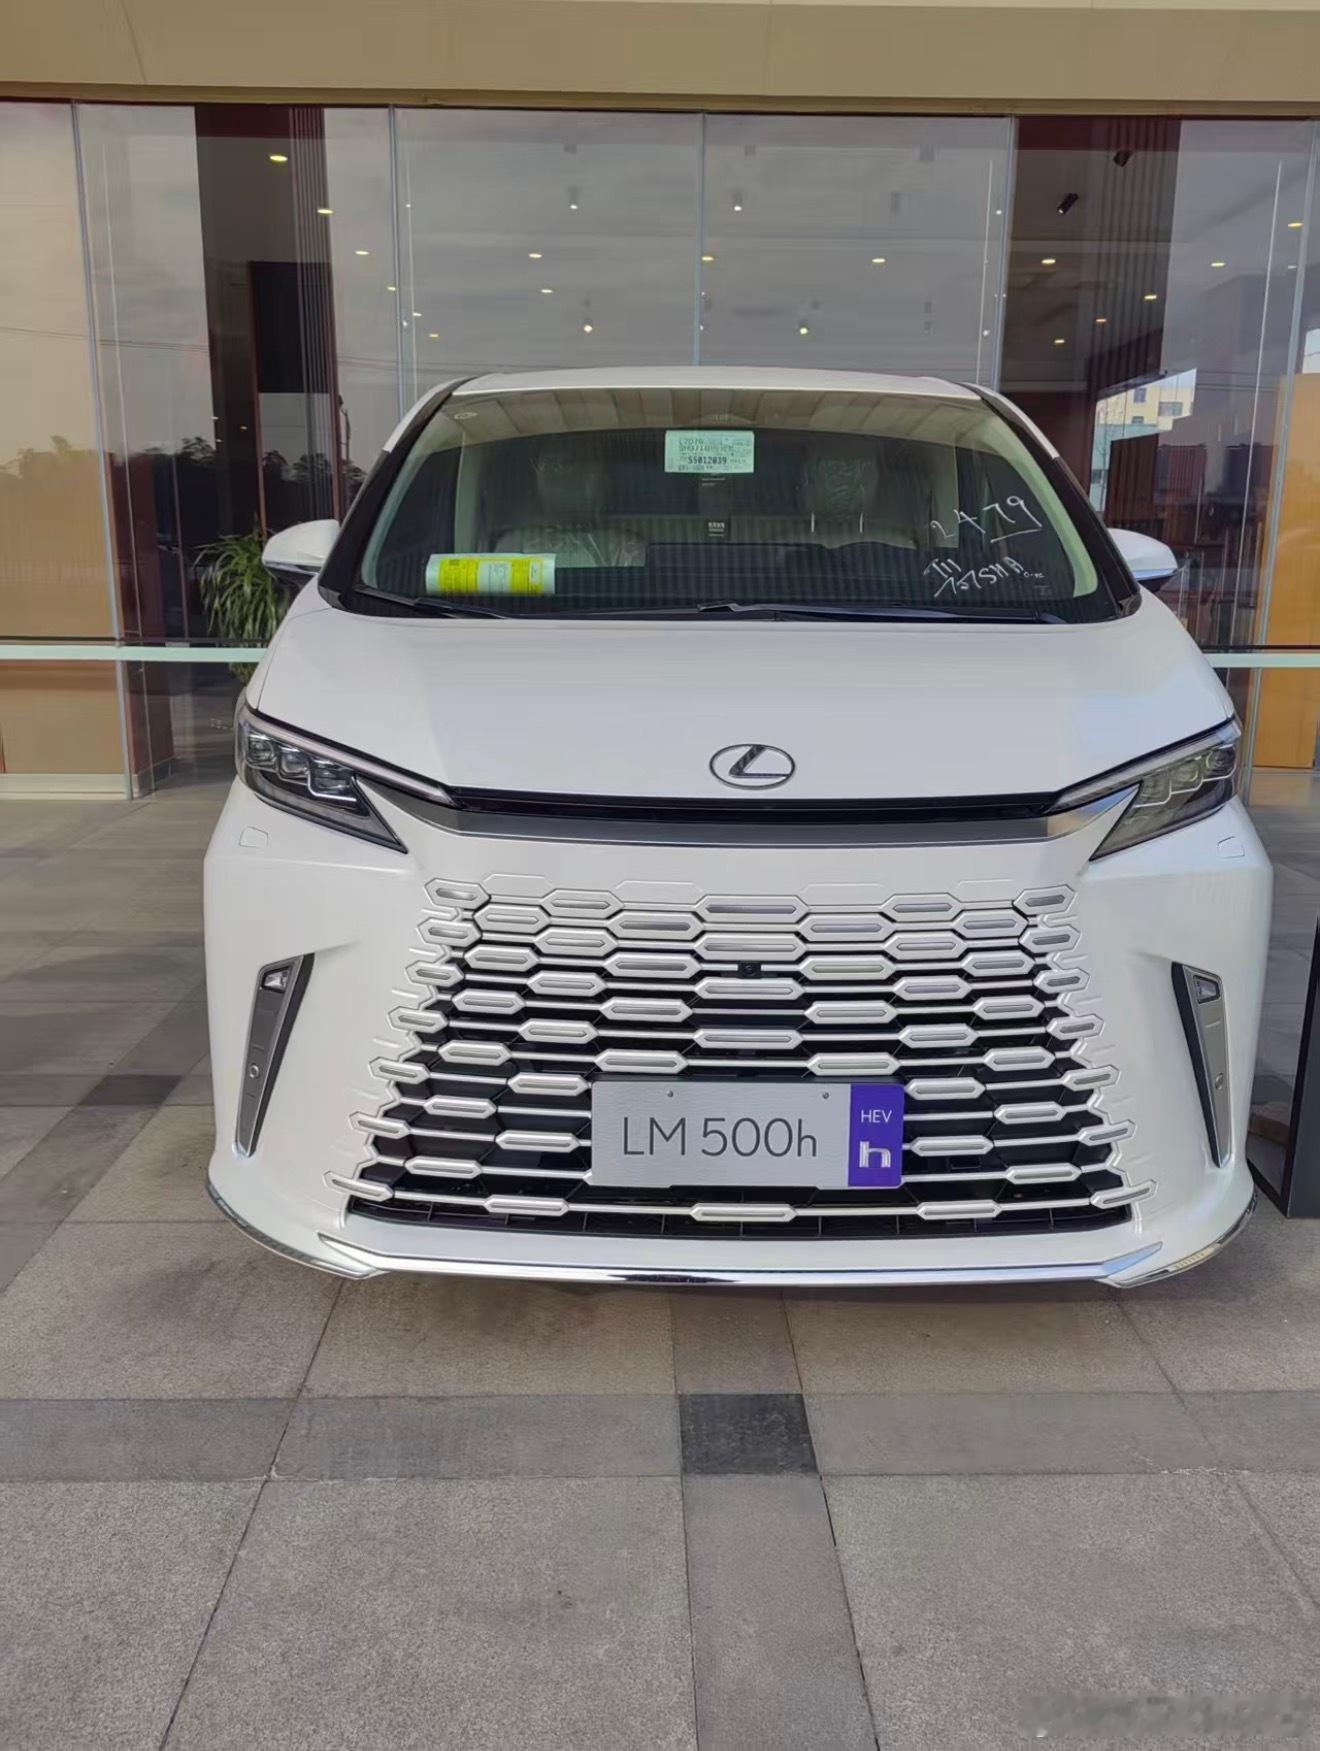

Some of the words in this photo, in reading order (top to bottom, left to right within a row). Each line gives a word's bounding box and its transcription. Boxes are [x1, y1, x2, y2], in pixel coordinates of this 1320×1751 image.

[860, 1109, 893, 1123] HEV
[623, 1116, 687, 1156] LM
[701, 1117, 818, 1157] 500h
